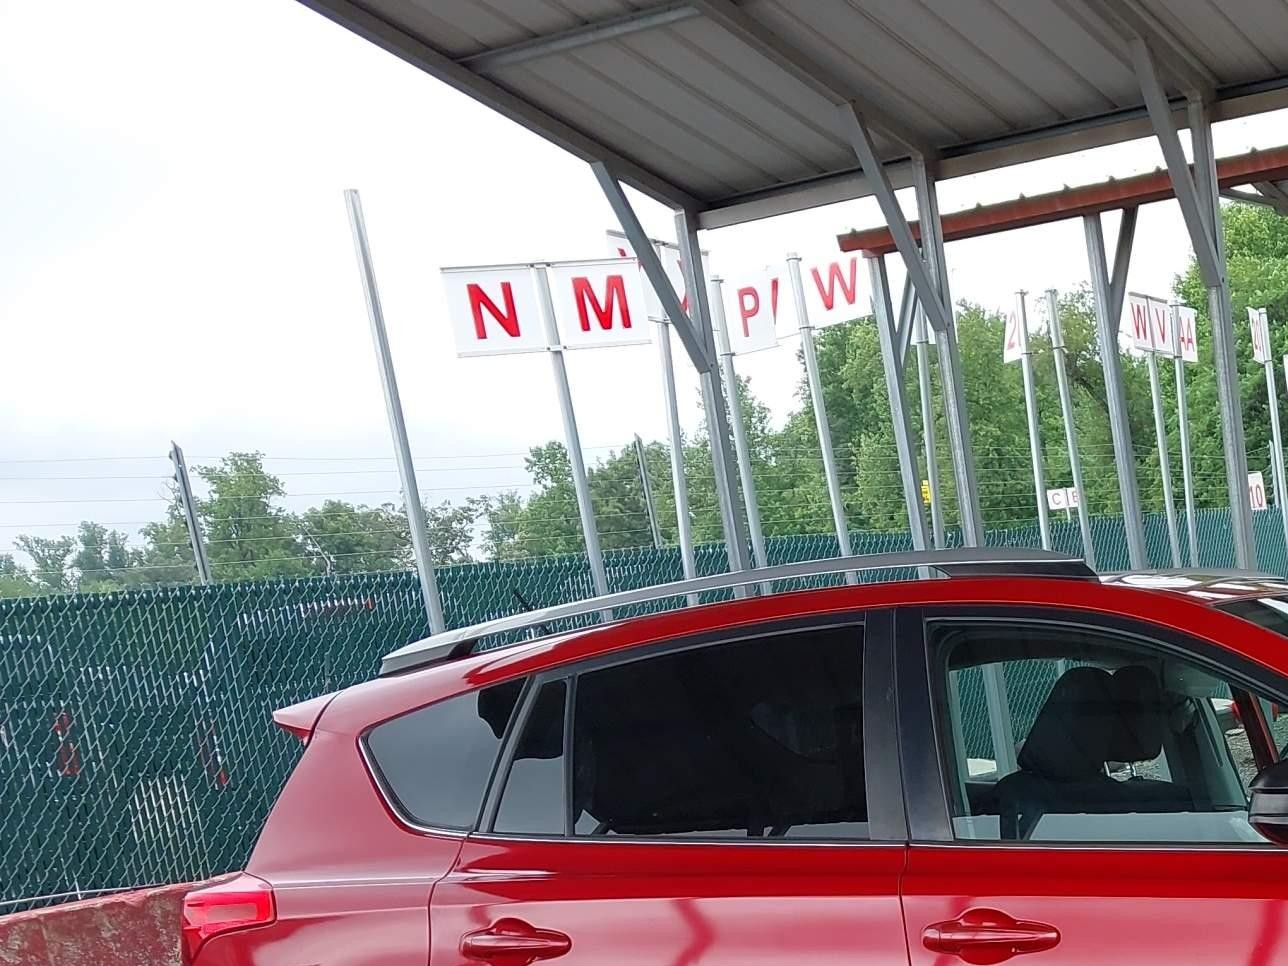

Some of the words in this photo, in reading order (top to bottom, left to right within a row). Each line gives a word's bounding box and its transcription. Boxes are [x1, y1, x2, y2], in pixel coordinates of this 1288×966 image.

[466, 281, 521, 340] N
[571, 275, 633, 332] M
[811, 257, 858, 312] W
[737, 286, 760, 338] P
[1130, 302, 1147, 341] W
[1155, 307, 1165, 345] V
[1051, 492, 1062, 506] C
